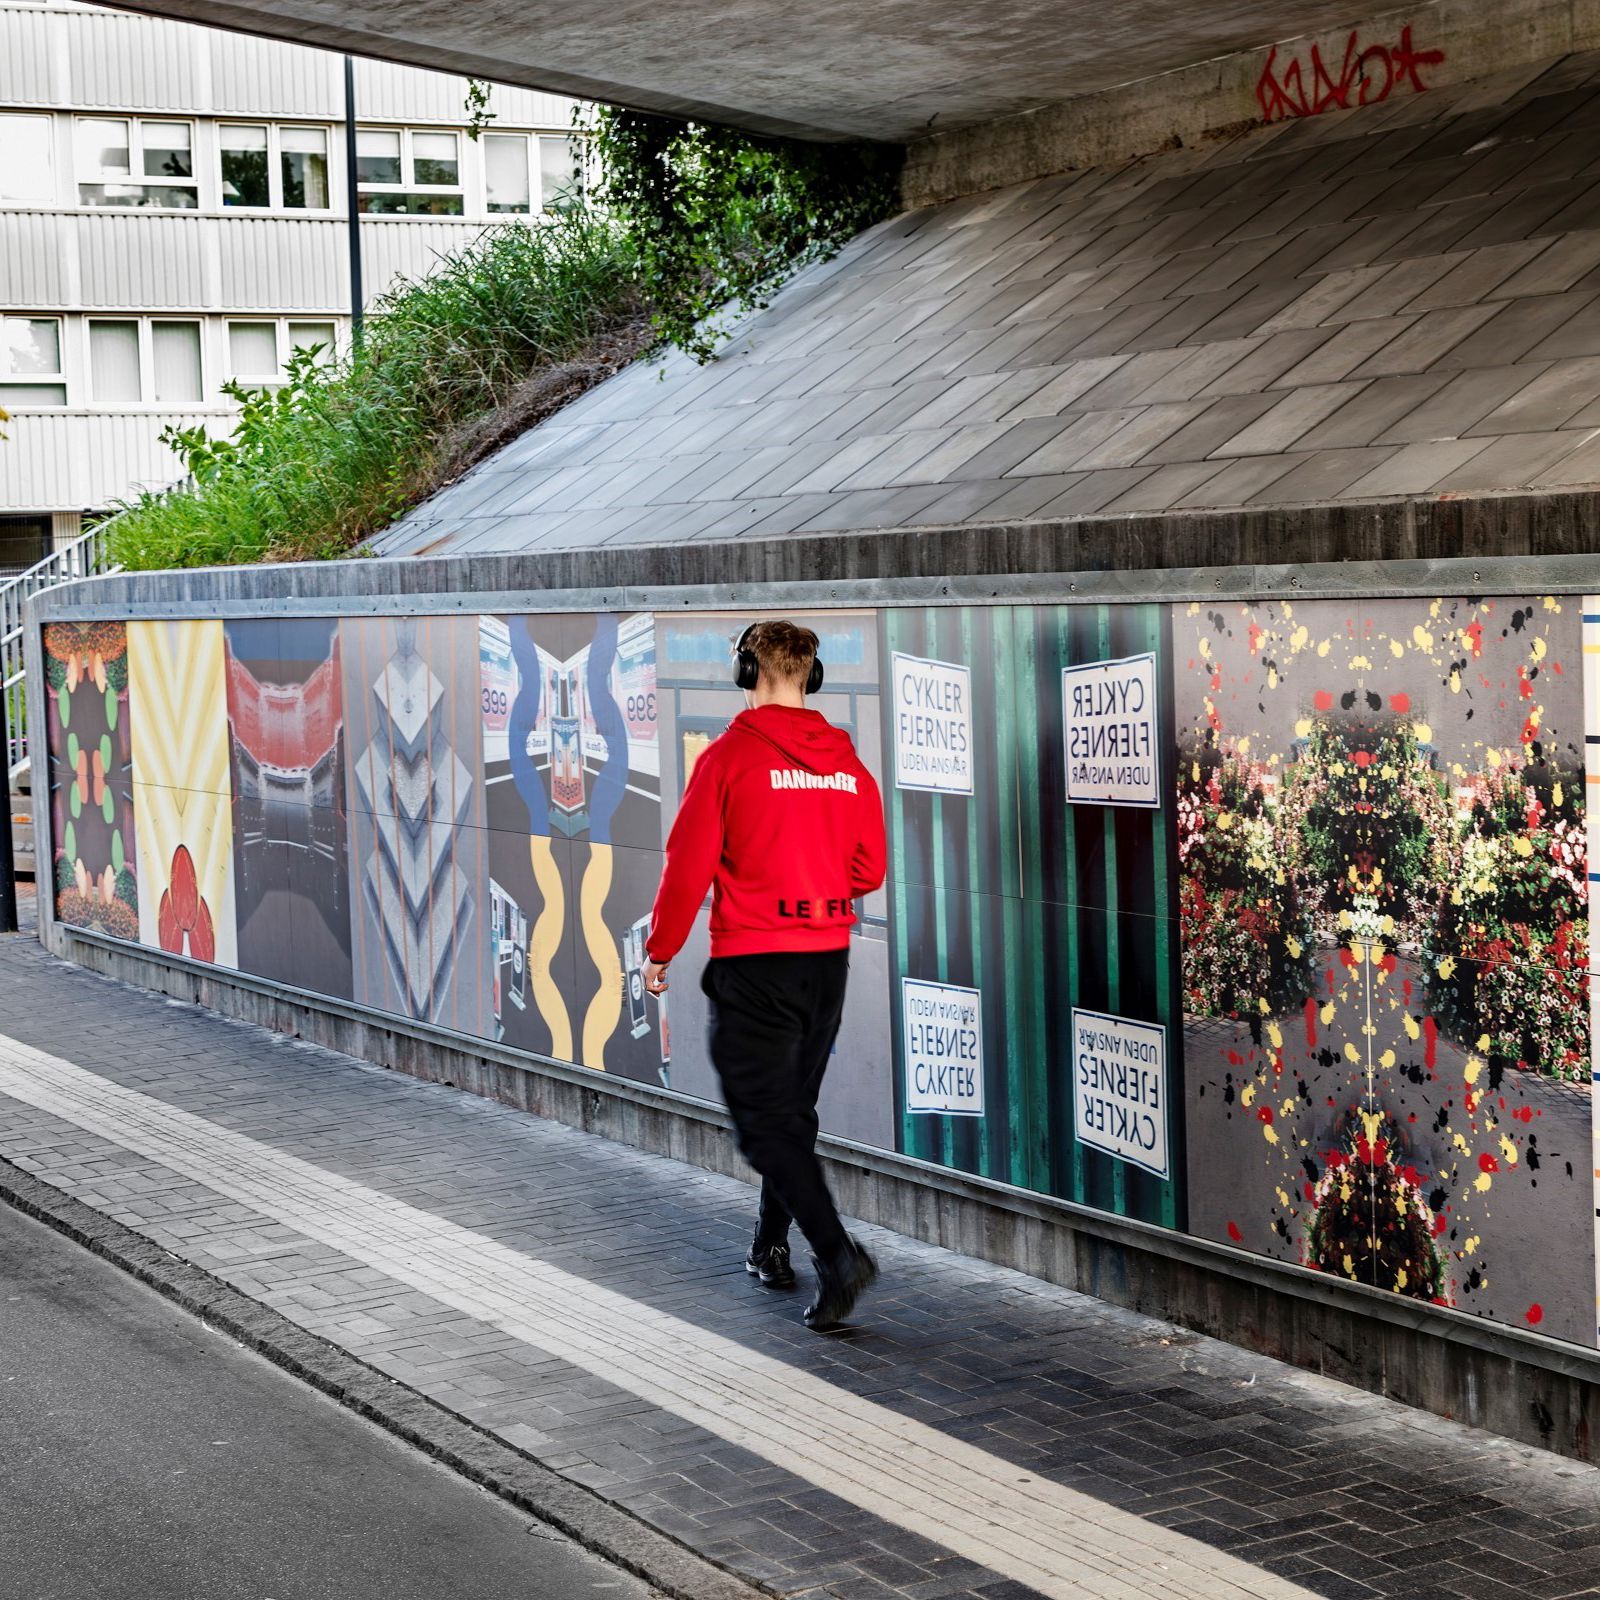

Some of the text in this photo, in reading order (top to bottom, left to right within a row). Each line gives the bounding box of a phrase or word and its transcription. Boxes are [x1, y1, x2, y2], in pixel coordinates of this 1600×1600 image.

[481, 687, 507, 715] 399
[902, 674, 963, 714] CYKLER
[901, 713, 967, 752] FJERNES
[902, 753, 929, 772] UDEN
[769, 769, 857, 795] DANMARK
[778, 899, 810, 918] LE
[1125, 1041, 1158, 1065] UDEN
[1080, 1053, 1159, 1109] FJERNES
[1084, 1094, 1156, 1150] CYKLER
